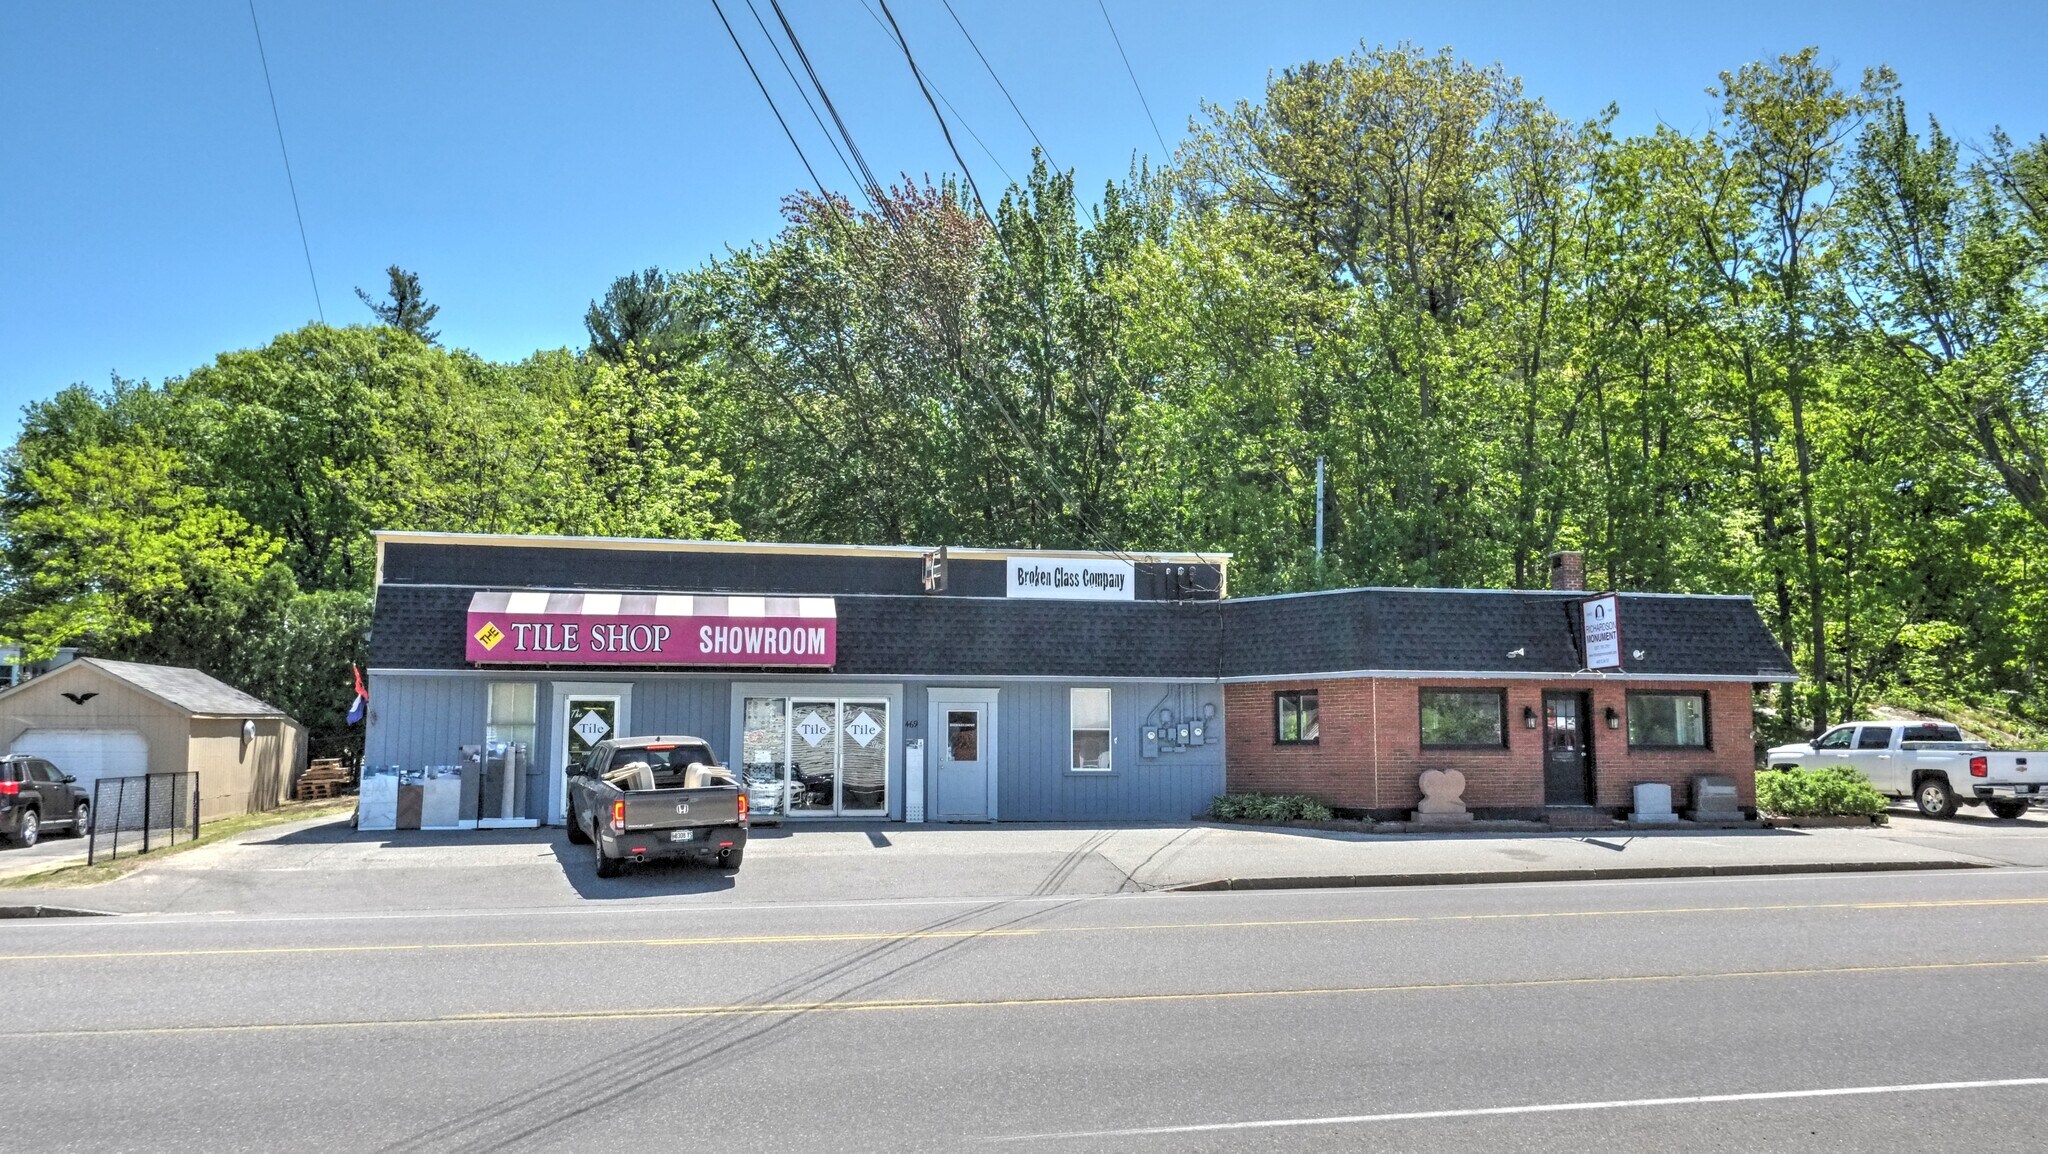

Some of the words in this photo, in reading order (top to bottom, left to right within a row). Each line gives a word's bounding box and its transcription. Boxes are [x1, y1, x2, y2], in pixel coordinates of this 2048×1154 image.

[1018, 565, 1051, 587] Broken
[1054, 567, 1079, 588] Glass
[1082, 568, 1125, 592] Company
[1586, 621, 1616, 633] RICHARDSON
[479, 626, 500, 645] THE
[511, 622, 580, 652] TILE
[590, 624, 671, 653] SHOP
[700, 625, 826, 655] SHOWROOM
[1586, 631, 1617, 643] MONUMENT
[571, 709, 583, 718] The
[580, 723, 604, 734] Tile
[802, 724, 827, 735] Tile
[851, 724, 876, 735] Tile
[905, 720, 919, 728] 469
